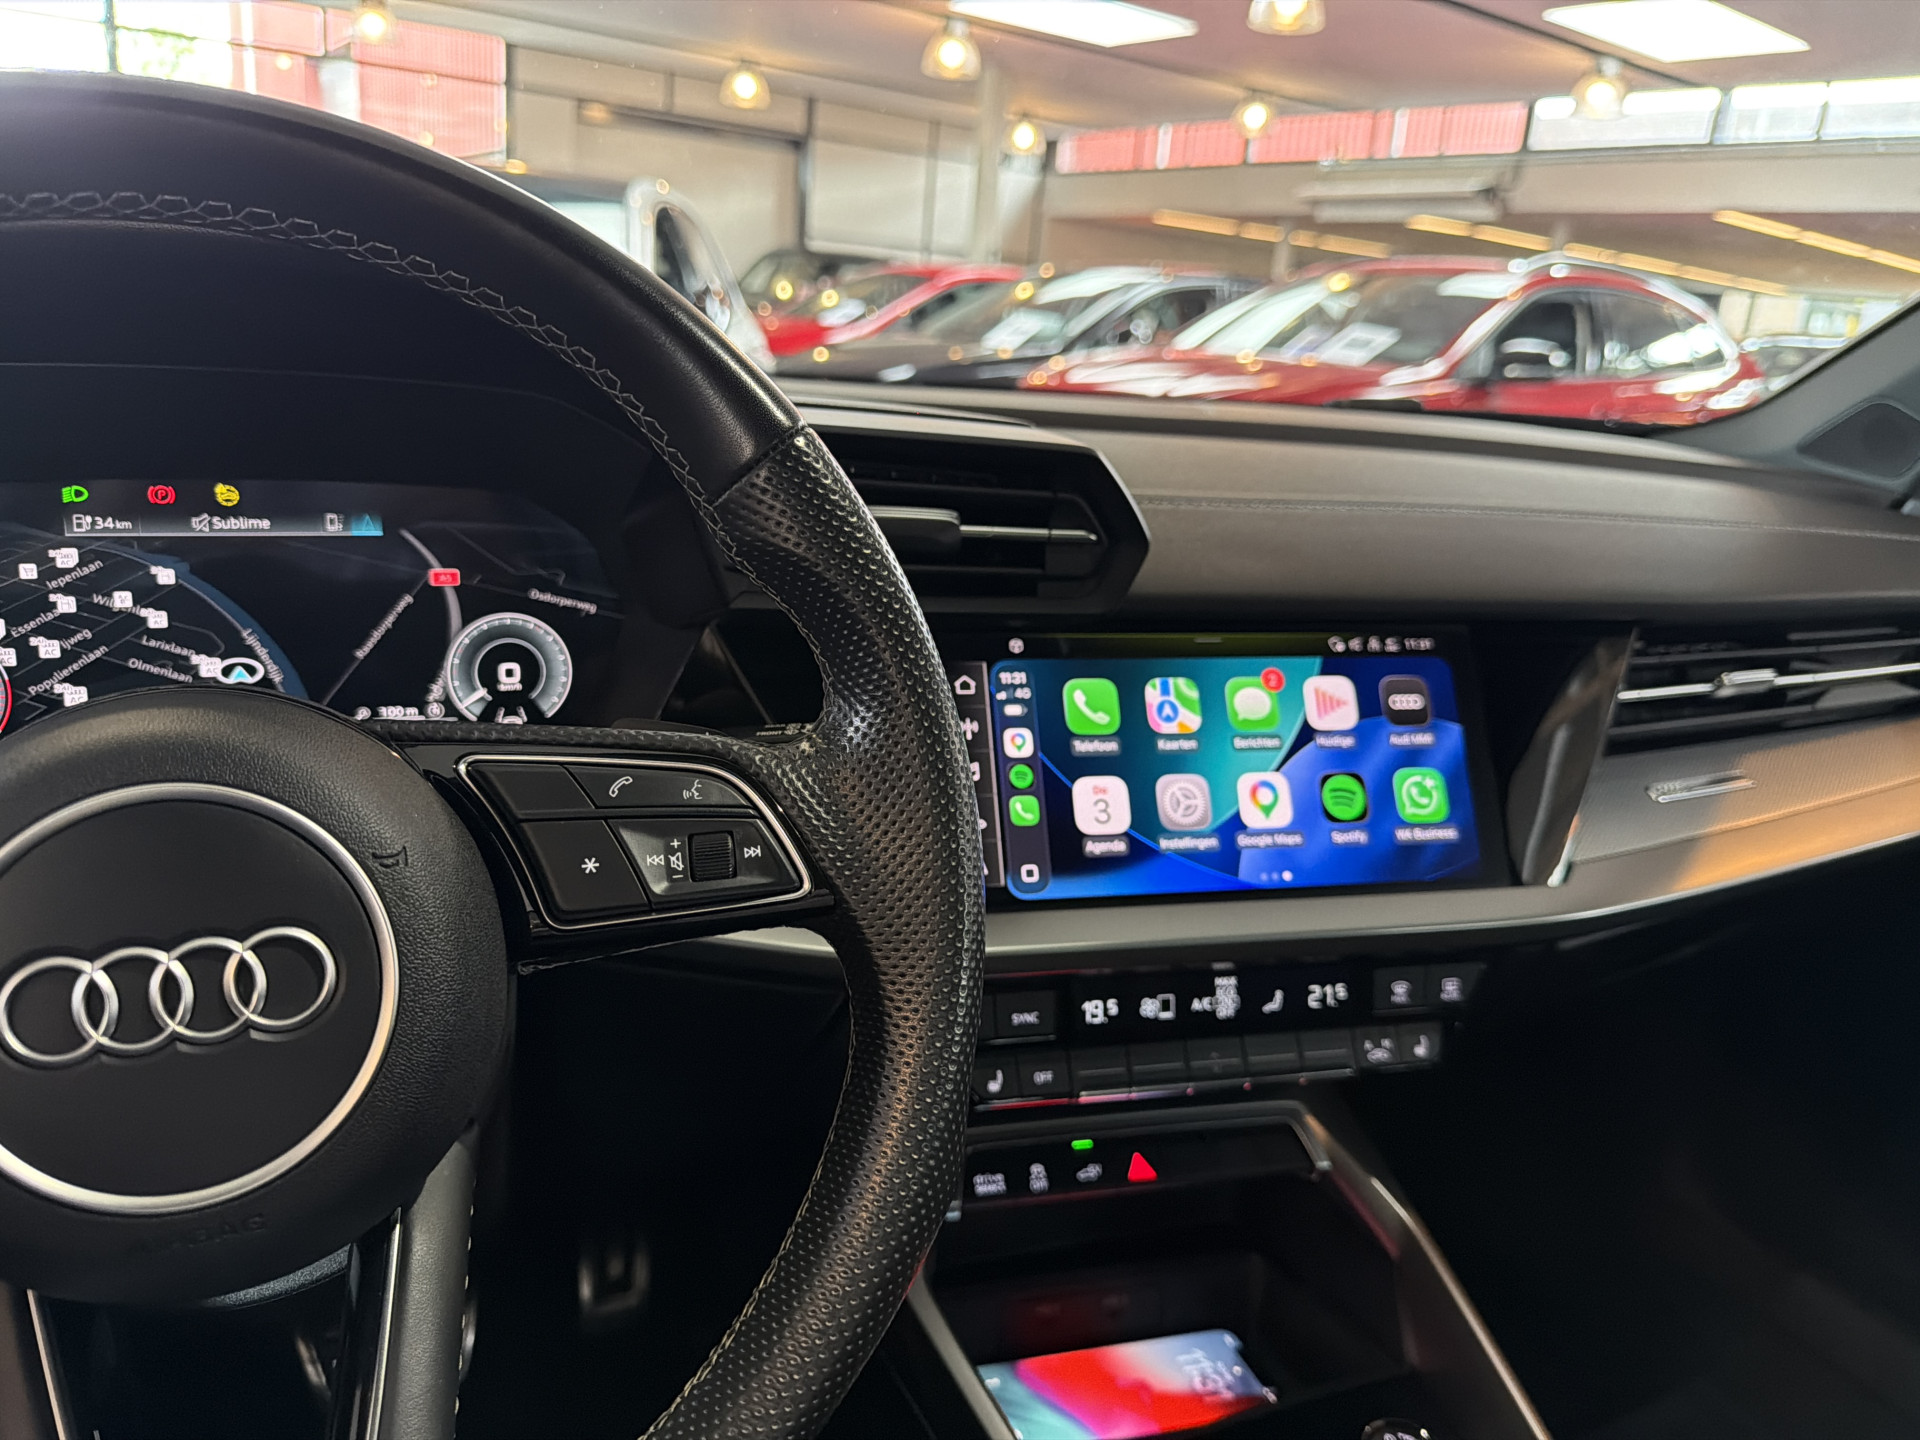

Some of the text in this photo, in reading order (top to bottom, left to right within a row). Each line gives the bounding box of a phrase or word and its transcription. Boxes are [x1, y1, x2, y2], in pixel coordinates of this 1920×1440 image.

[94, 517, 133, 530] 34 km
[211, 516, 271, 530] Sublime
[45, 560, 104, 590] Iepenlaan
[10, 608, 61, 638] Essenlaa
[141, 634, 196, 658] Larixlaan
[28, 645, 109, 696] Populierenlaan
[127, 657, 193, 684] Olmenlaan
[498, 662, 521, 683] 0
[1073, 739, 1119, 752] Telefoon
[1157, 739, 1198, 750] Kaarten
[1094, 798, 1111, 824] 3
[1085, 838, 1127, 855] Agenda
[1237, 833, 1303, 848] Google Maps
[1331, 830, 1369, 844] Spotify
